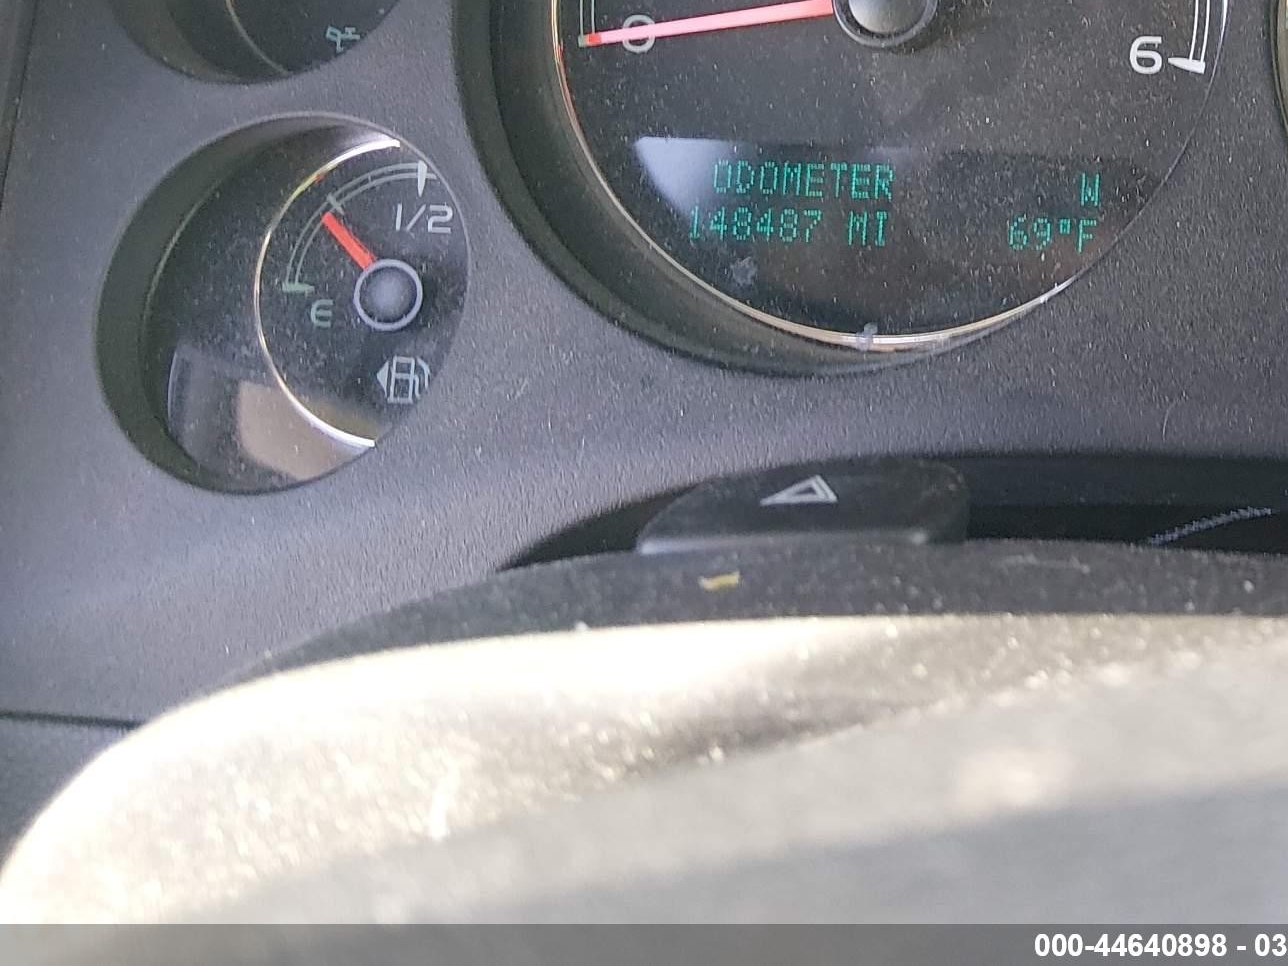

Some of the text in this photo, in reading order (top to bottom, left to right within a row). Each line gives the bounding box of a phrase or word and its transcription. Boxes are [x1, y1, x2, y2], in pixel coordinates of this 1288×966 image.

[622, 14, 656, 53] 0
[1129, 35, 1163, 75] 6
[713, 160, 894, 202] ODOMETER
[1080, 173, 1099, 206] W
[395, 201, 454, 234] 1/2
[690, 205, 888, 246] 148487 MI
[310, 298, 334, 327] E
